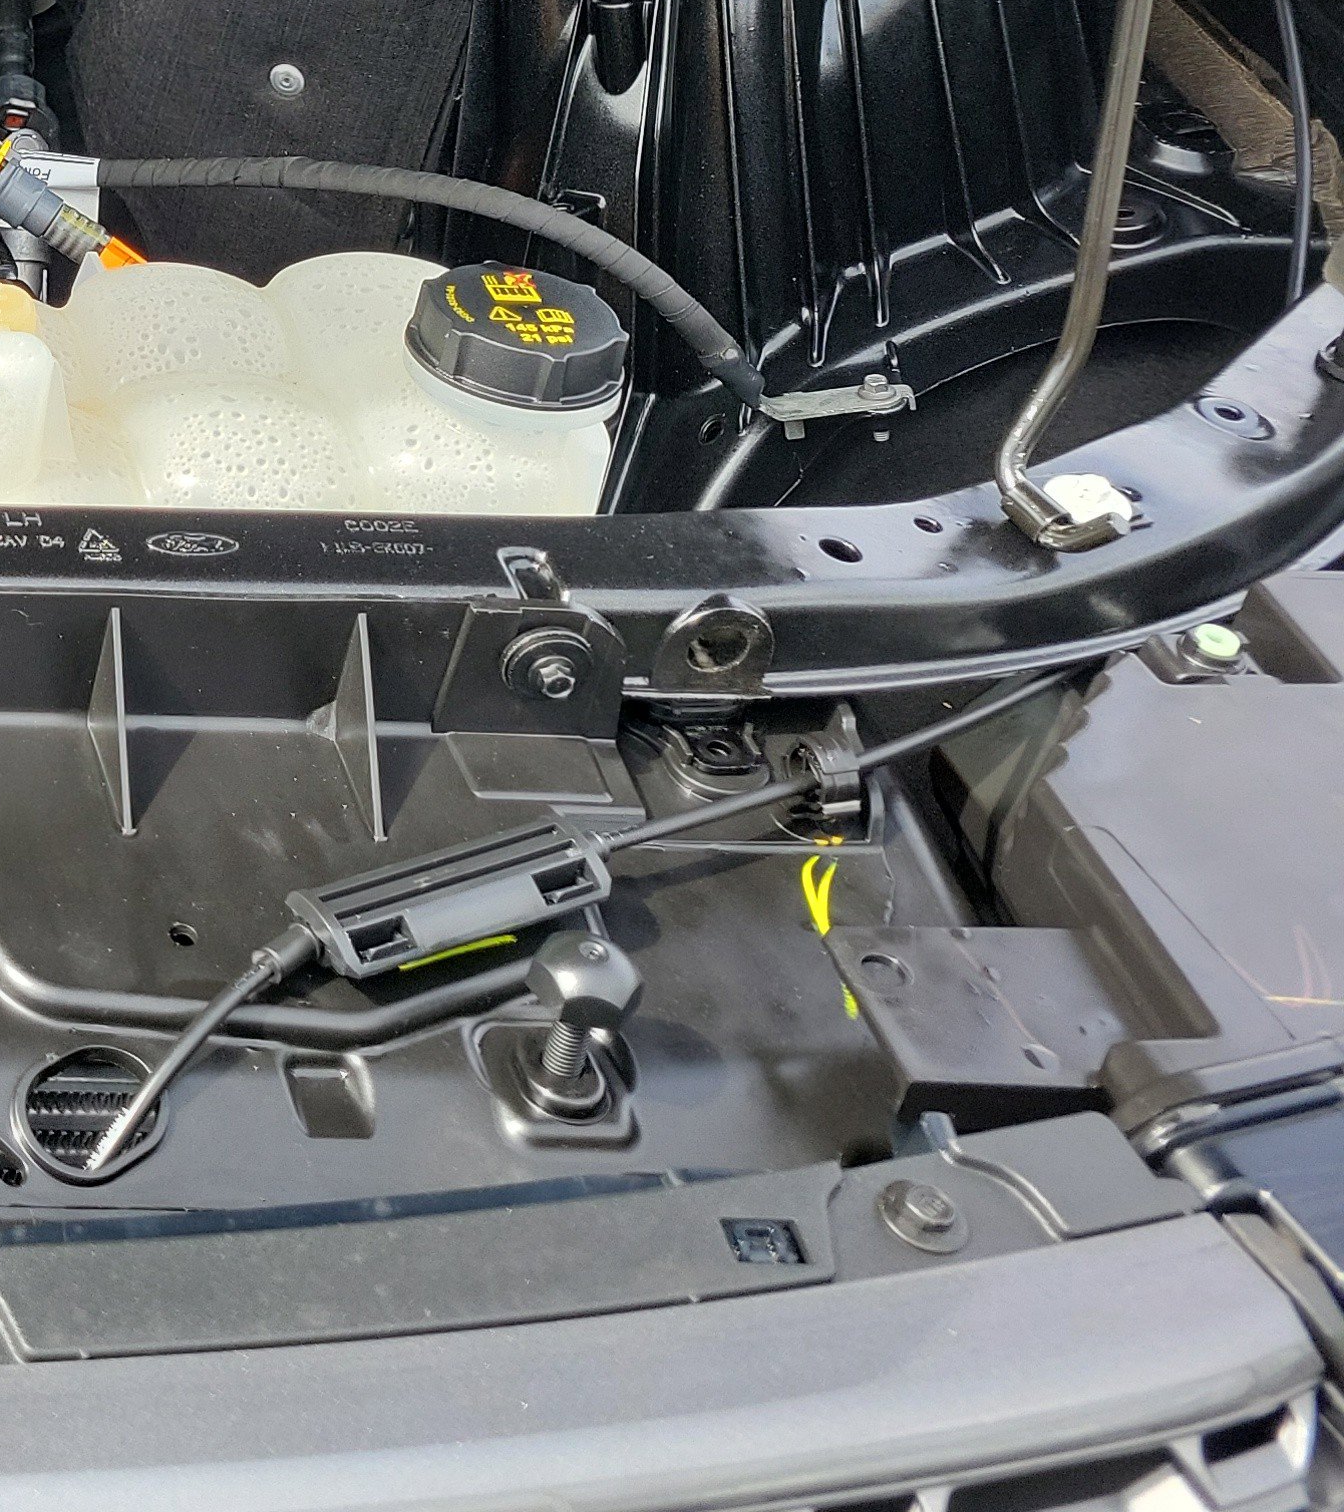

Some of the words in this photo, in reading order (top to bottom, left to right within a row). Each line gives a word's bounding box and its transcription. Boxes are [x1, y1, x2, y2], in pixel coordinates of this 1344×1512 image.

[505, 322, 538, 333] 145
[539, 323, 575, 334] kPa
[519, 333, 543, 343] 21
[545, 334, 575, 344] psi
[2, 511, 43, 527] LH
